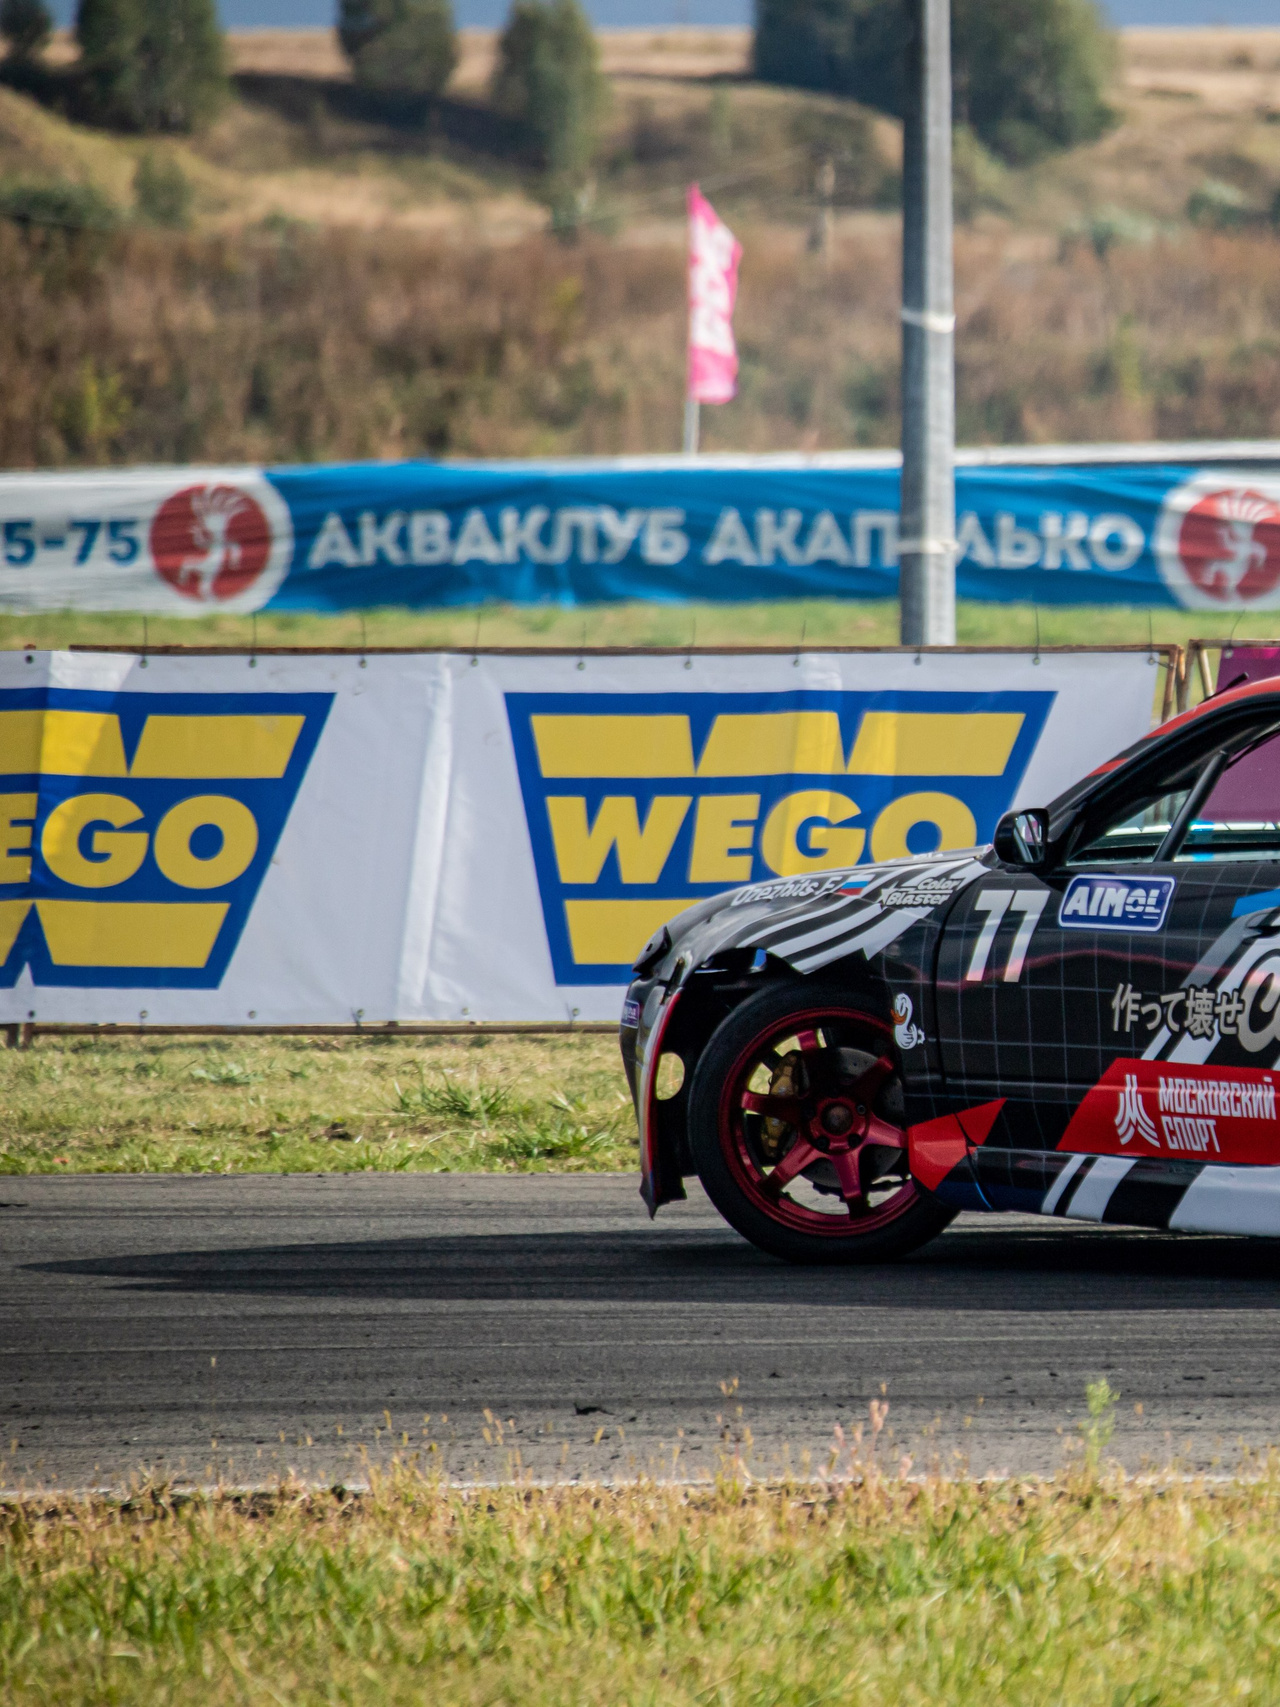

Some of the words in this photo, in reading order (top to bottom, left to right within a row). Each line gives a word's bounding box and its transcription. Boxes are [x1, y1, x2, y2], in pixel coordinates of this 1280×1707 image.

[307, 506, 690, 568] АКВАКЛУБ
[705, 506, 1146, 571] АКАПЛЬКО
[546, 790, 977, 885] WEGO
[889, 892, 951, 906] Blaster
[917, 877, 961, 891] Color
[1064, 886, 1161, 919] AIMOL
[967, 890, 1049, 982] 77
[1111, 983, 1243, 1041] 作って壊せ
[1159, 1076, 1277, 1121] МОСКОВСКИЙ
[1161, 1116, 1221, 1153] СПОРТ
